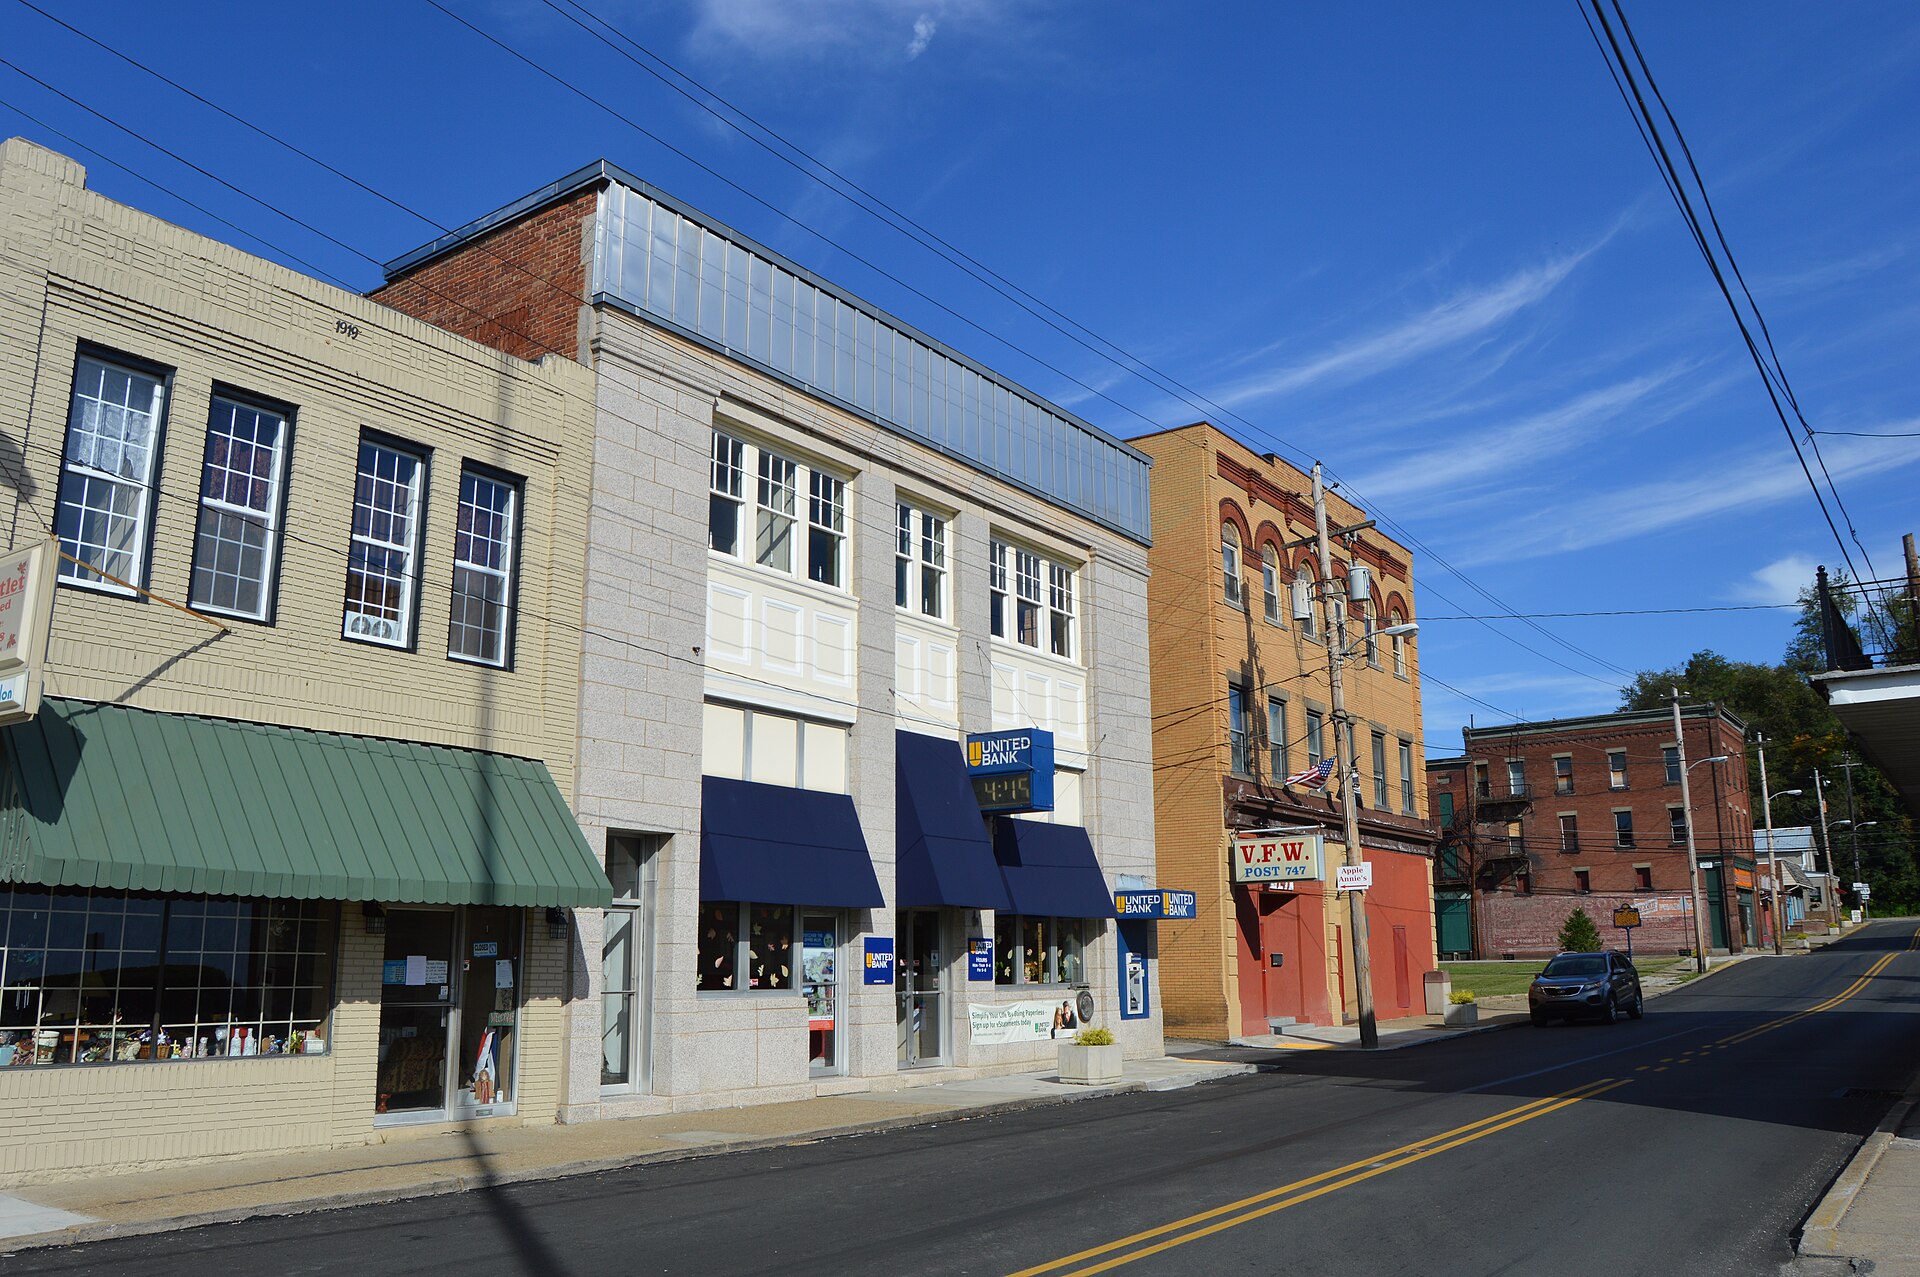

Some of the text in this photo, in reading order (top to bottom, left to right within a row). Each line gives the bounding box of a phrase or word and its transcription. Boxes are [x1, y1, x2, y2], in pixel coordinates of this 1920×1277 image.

[335, 320, 361, 340] 1919
[981, 736, 1031, 754] UNITED
[981, 750, 1018, 767] BANK
[1239, 842, 1310, 864] V.F.W.
[1244, 865, 1307, 878] POST 747
[1341, 867, 1364, 875] Apple
[1339, 874, 1368, 883] Annie's
[1125, 895, 1160, 905] UNITED
[1168, 892, 1194, 905] UNITED
[1125, 904, 1152, 914] BANK
[1169, 905, 1188, 916] BANK
[975, 941, 993, 949] UNITED
[871, 953, 893, 961] UNITED
[871, 961, 888, 969] BANK
[972, 1012, 989, 1021] Simplify
[989, 1011, 999, 1019] Your
[1025, 1009, 1045, 1018] Paperless
[972, 1022, 983, 1030] Sign
